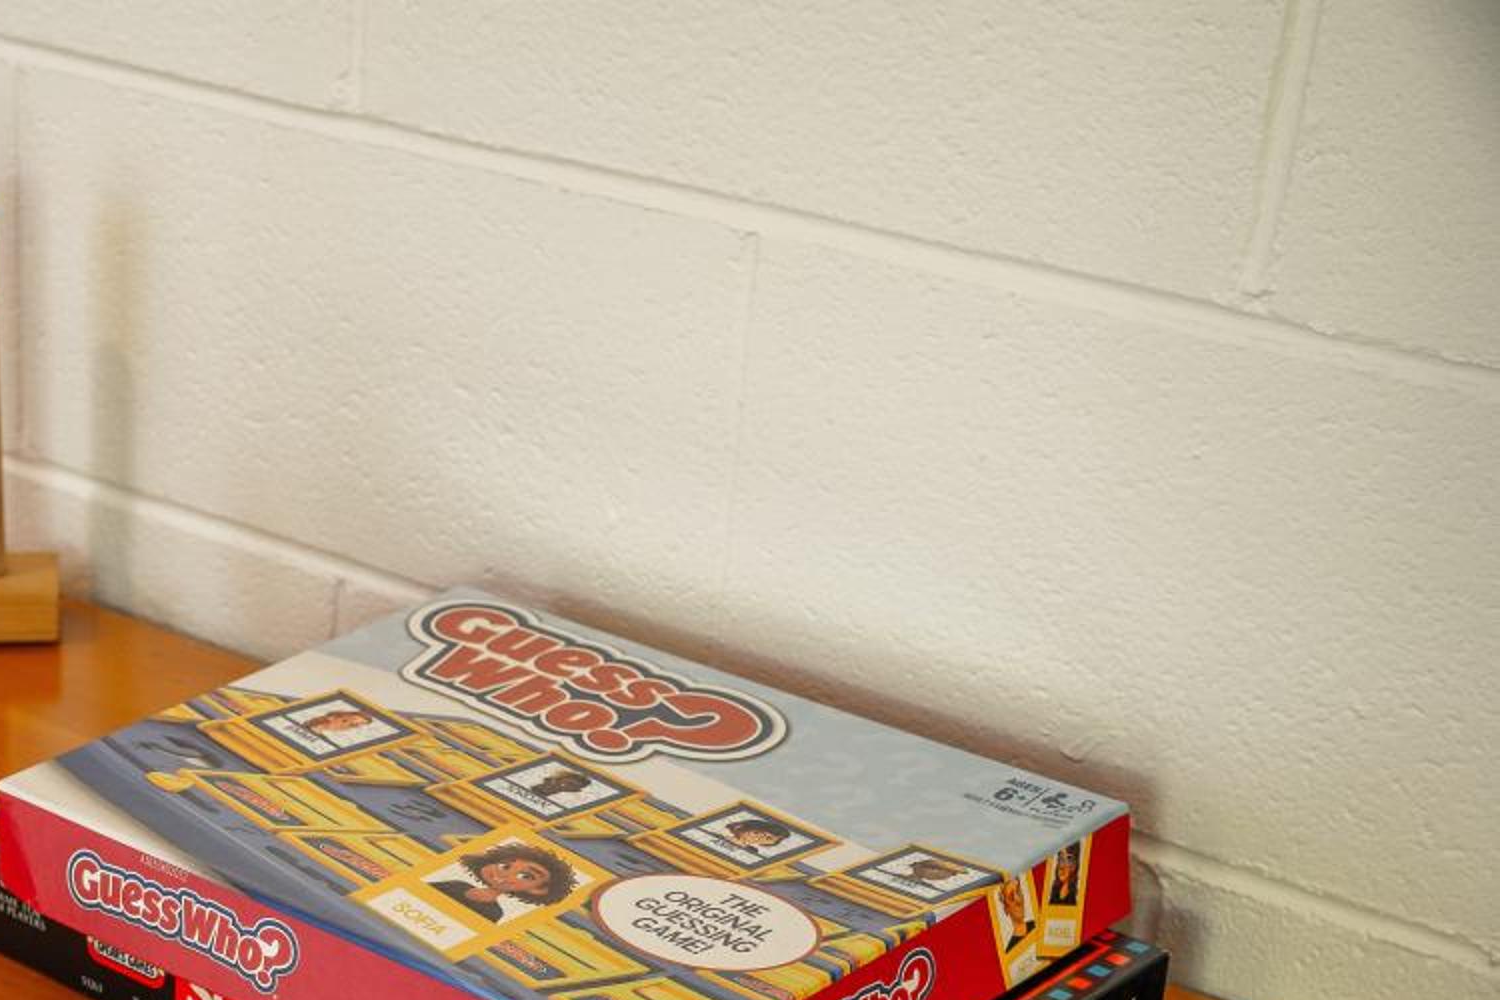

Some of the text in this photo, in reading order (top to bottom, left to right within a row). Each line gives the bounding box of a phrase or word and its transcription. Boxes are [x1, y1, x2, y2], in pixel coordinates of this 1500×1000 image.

[391, 903, 448, 936] SOFIA
[662, 889, 774, 943] ORIGINAL
[719, 892, 772, 918] THE
[630, 916, 716, 955] GAME!
[634, 896, 758, 954] GUESSING
